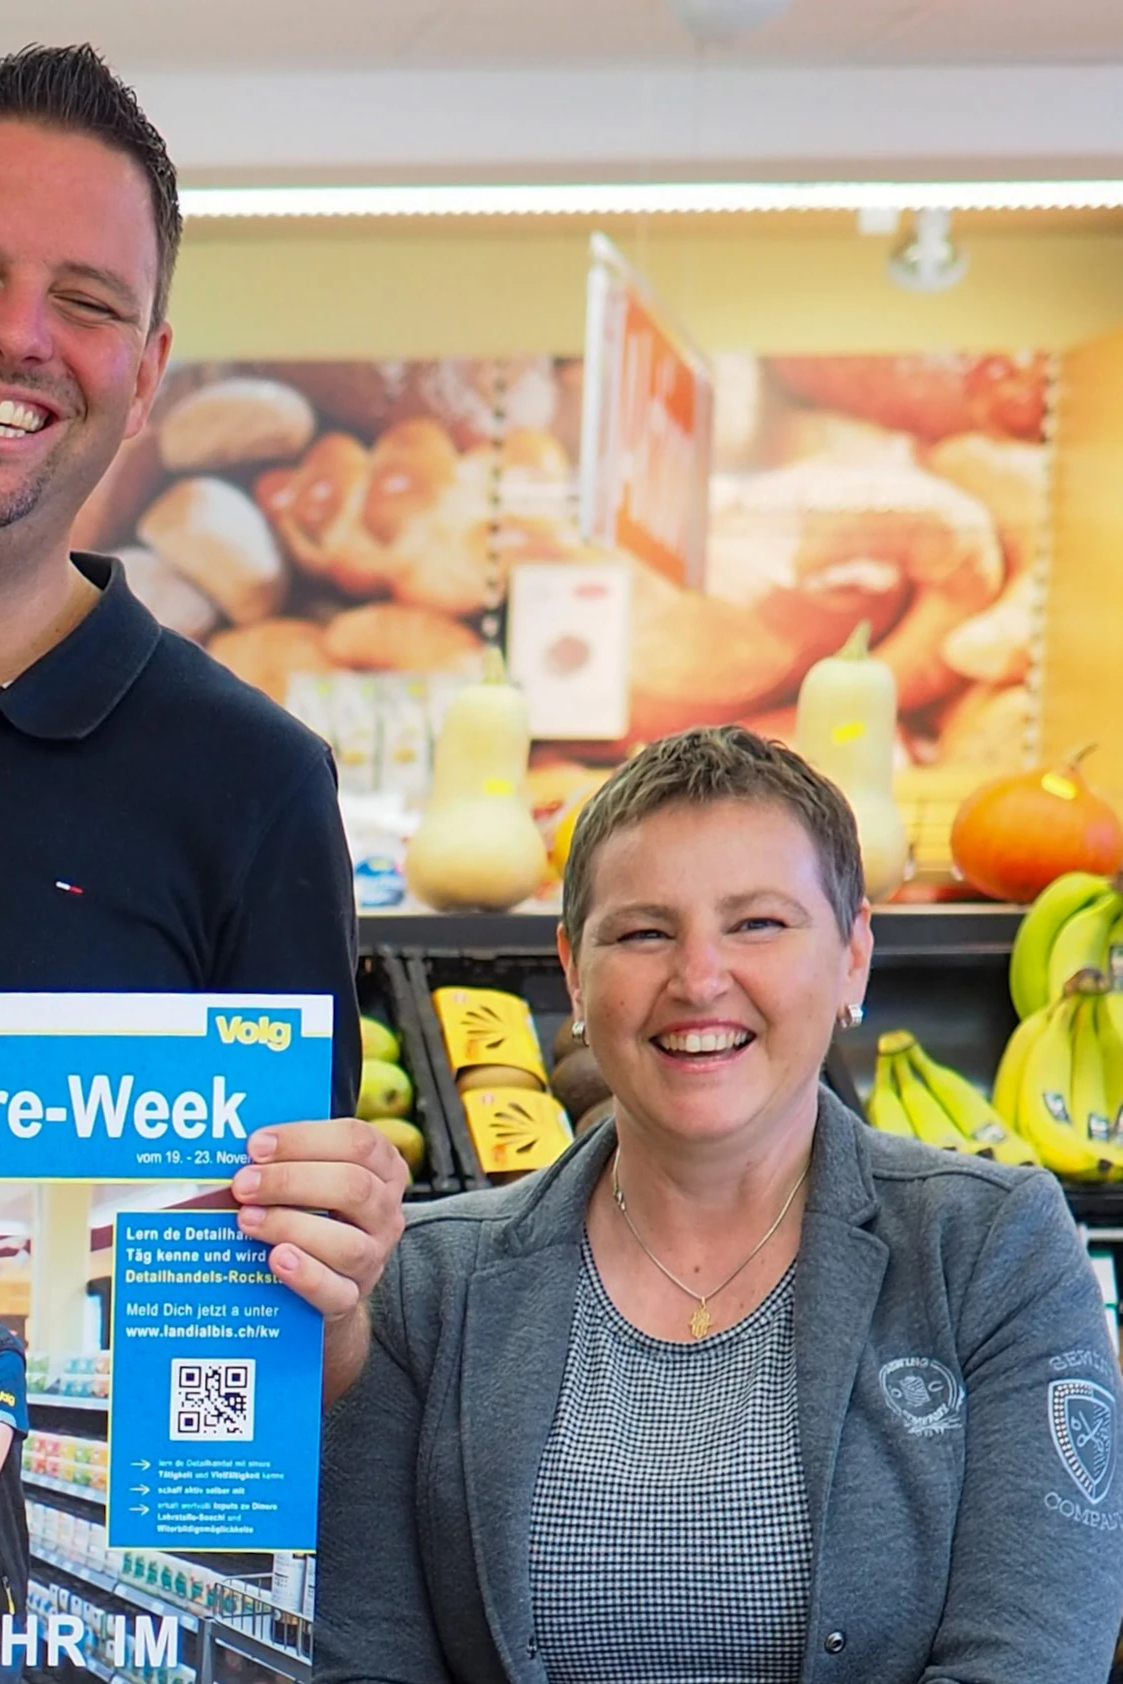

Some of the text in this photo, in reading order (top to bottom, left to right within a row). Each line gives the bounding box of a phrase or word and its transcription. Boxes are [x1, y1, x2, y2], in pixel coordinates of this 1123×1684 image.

[215, 1015, 292, 1051] Volg
[136, 1152, 162, 1164] vom
[165, 1150, 183, 1164] 19.
[194, 1150, 213, 1164] 23.
[126, 1227, 158, 1240] Lern
[163, 1227, 181, 1240] de
[157, 1248, 199, 1262] kenne
[204, 1249, 230, 1262] und
[235, 1250, 266, 1262] wird
[125, 1269, 283, 1284] Detailhandels-Rockst
[126, 1303, 280, 1320] Meld Dich jetzt a unter
[126, 1324, 280, 1338] www.landialbis.ch/kw
[114, 1614, 178, 1668] IM
